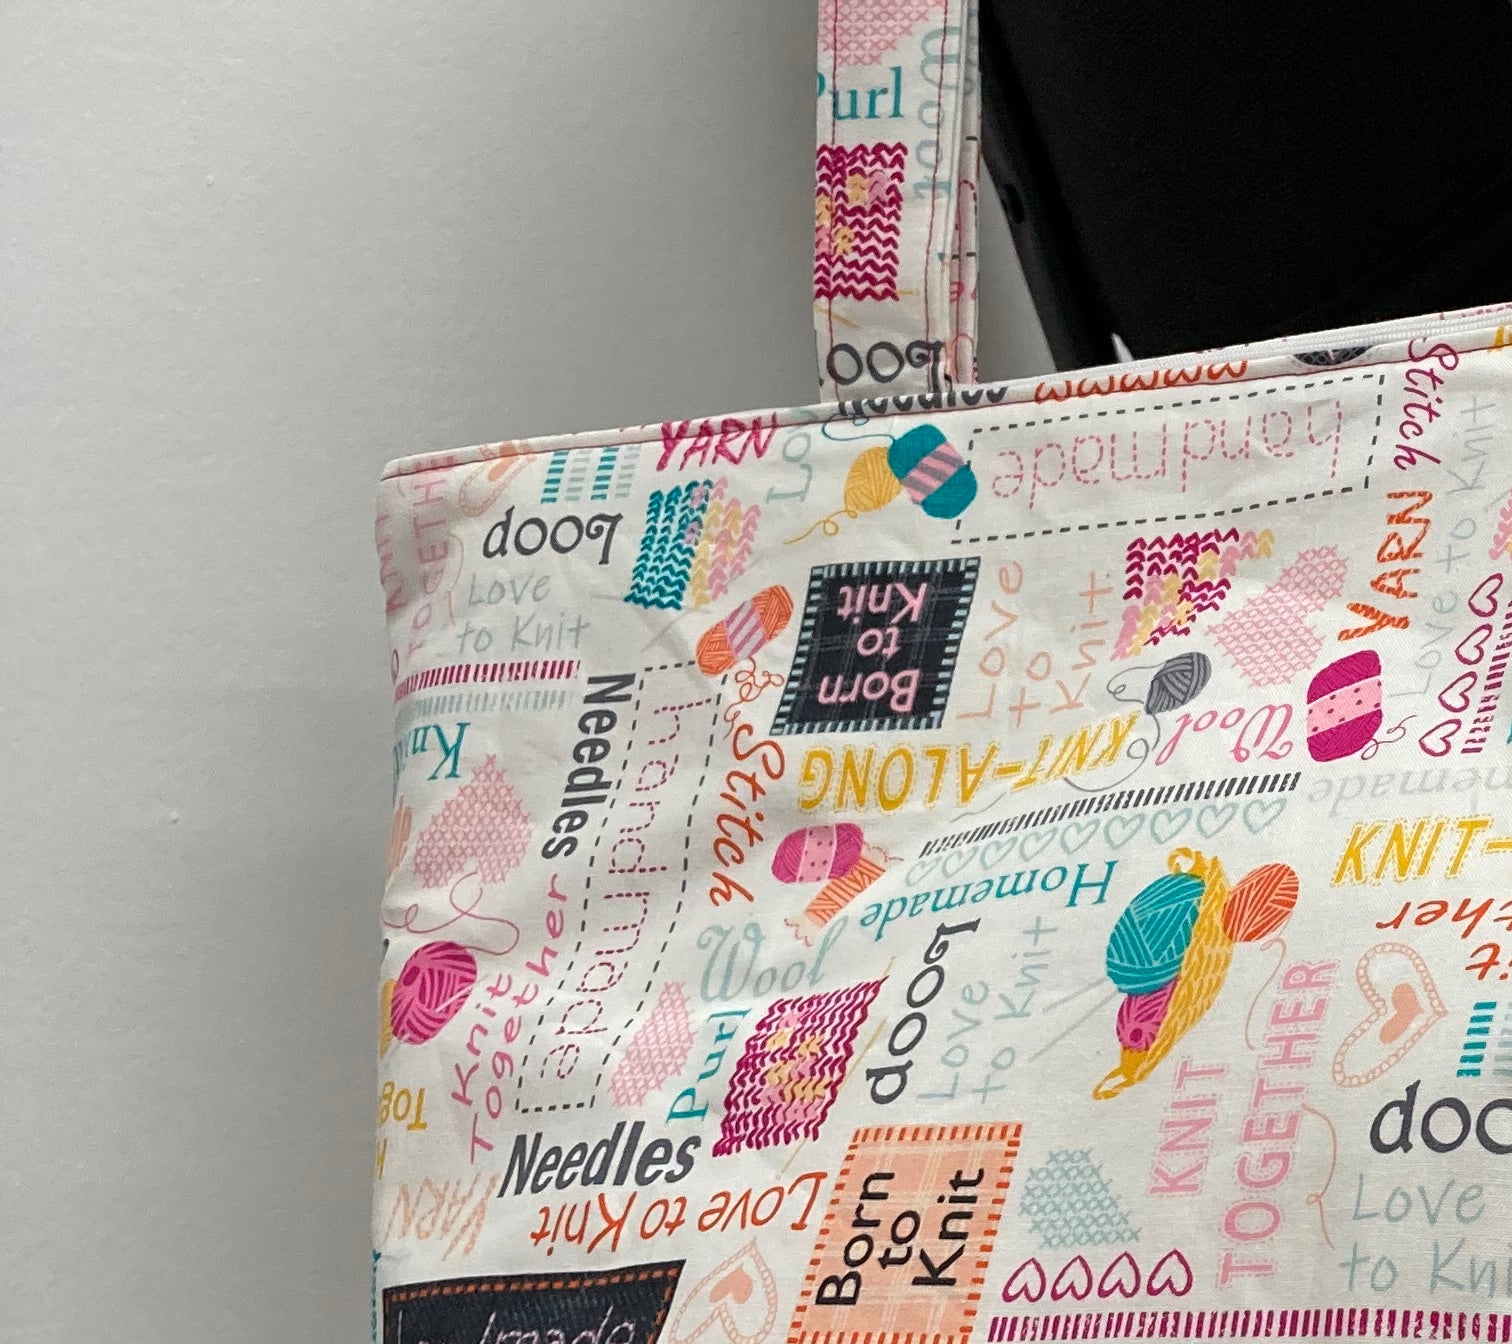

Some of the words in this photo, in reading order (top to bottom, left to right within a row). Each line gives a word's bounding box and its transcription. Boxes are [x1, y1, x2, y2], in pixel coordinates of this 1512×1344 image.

[826, 340, 946, 393] Loo
[1393, 334, 1460, 472] Stitch
[655, 411, 778, 472] YARN
[992, 400, 1343, 509] handmade
[482, 506, 624, 565] Loop
[1337, 490, 1433, 642] YARN
[456, 618, 493, 654] to
[511, 610, 591, 652] Knit
[468, 572, 551, 607] Love
[838, 581, 930, 623] Knit
[856, 623, 902, 659] to
[957, 559, 1024, 720] Love
[1050, 570, 1115, 714] Knit
[818, 666, 921, 714] Born
[1009, 650, 1053, 726] to
[1389, 594, 1457, 700] Love
[540, 672, 637, 860] Needles
[799, 709, 1142, 815] KNIT-ALONG
[1154, 703, 1294, 766] Wool
[708, 722, 786, 907] Stitch
[540, 696, 714, 1080] handmade
[861, 860, 1120, 941] Homemade
[697, 916, 849, 1003] Wool
[866, 917, 982, 1106] Loop
[967, 1056, 1015, 1106] to
[1000, 915, 1060, 1019] Knit
[451, 973, 514, 1105] Knit
[469, 873, 568, 1166] Together
[667, 1008, 752, 1126] Purl
[916, 978, 990, 1106] Love
[497, 1120, 702, 1199] Needles
[1151, 1056, 1229, 1197] KNIT
[1217, 958, 1341, 1291] TOGETHER
[530, 1191, 632, 1258] Knit
[640, 1194, 688, 1237] to
[697, 1170, 829, 1234] Love
[815, 1170, 897, 1307] Born
[879, 1209, 921, 1272] to
[911, 1167, 985, 1288] Knit
[1350, 1174, 1486, 1225] Love
[1339, 1241, 1400, 1296] to
